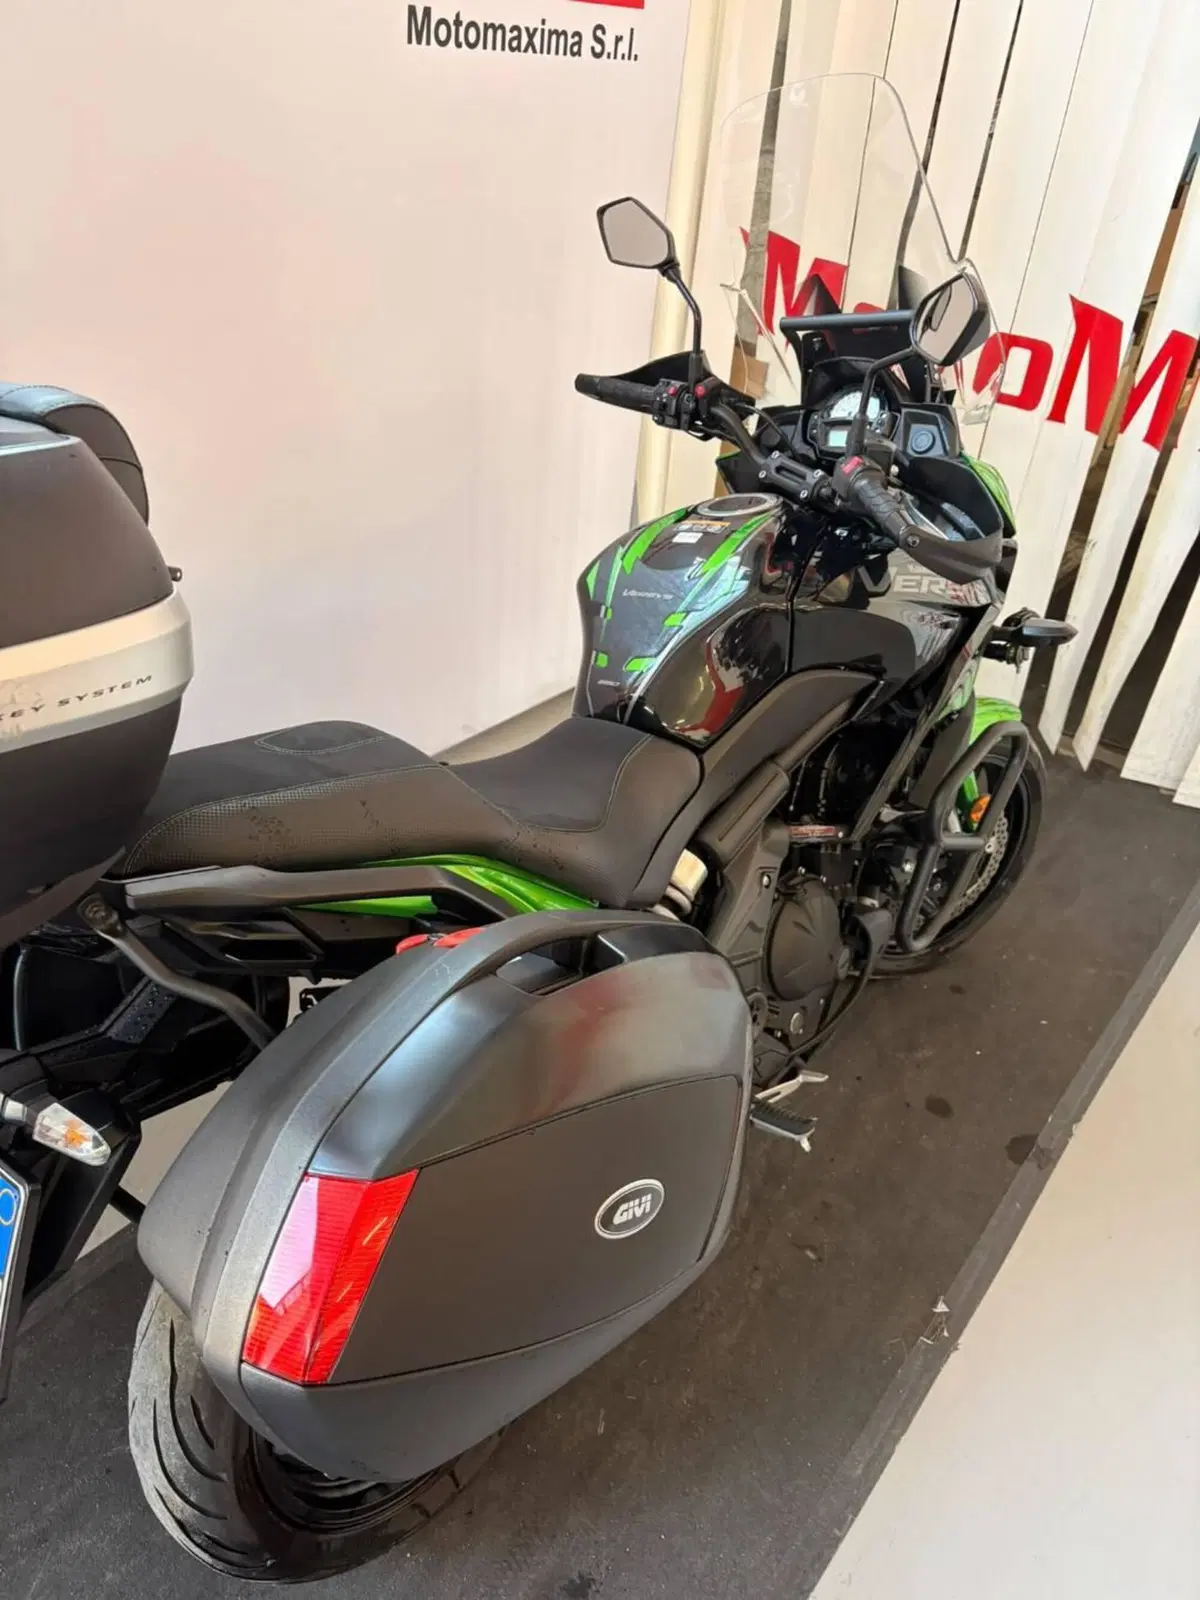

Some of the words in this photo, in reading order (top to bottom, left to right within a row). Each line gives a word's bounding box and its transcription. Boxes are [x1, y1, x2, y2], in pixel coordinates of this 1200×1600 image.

[406, 4, 583, 58] Motomaxima
[590, 23, 639, 62] S.r.l.
[57, 675, 153, 708] SYSTEM
[612, 1193, 653, 1226] GIVI
